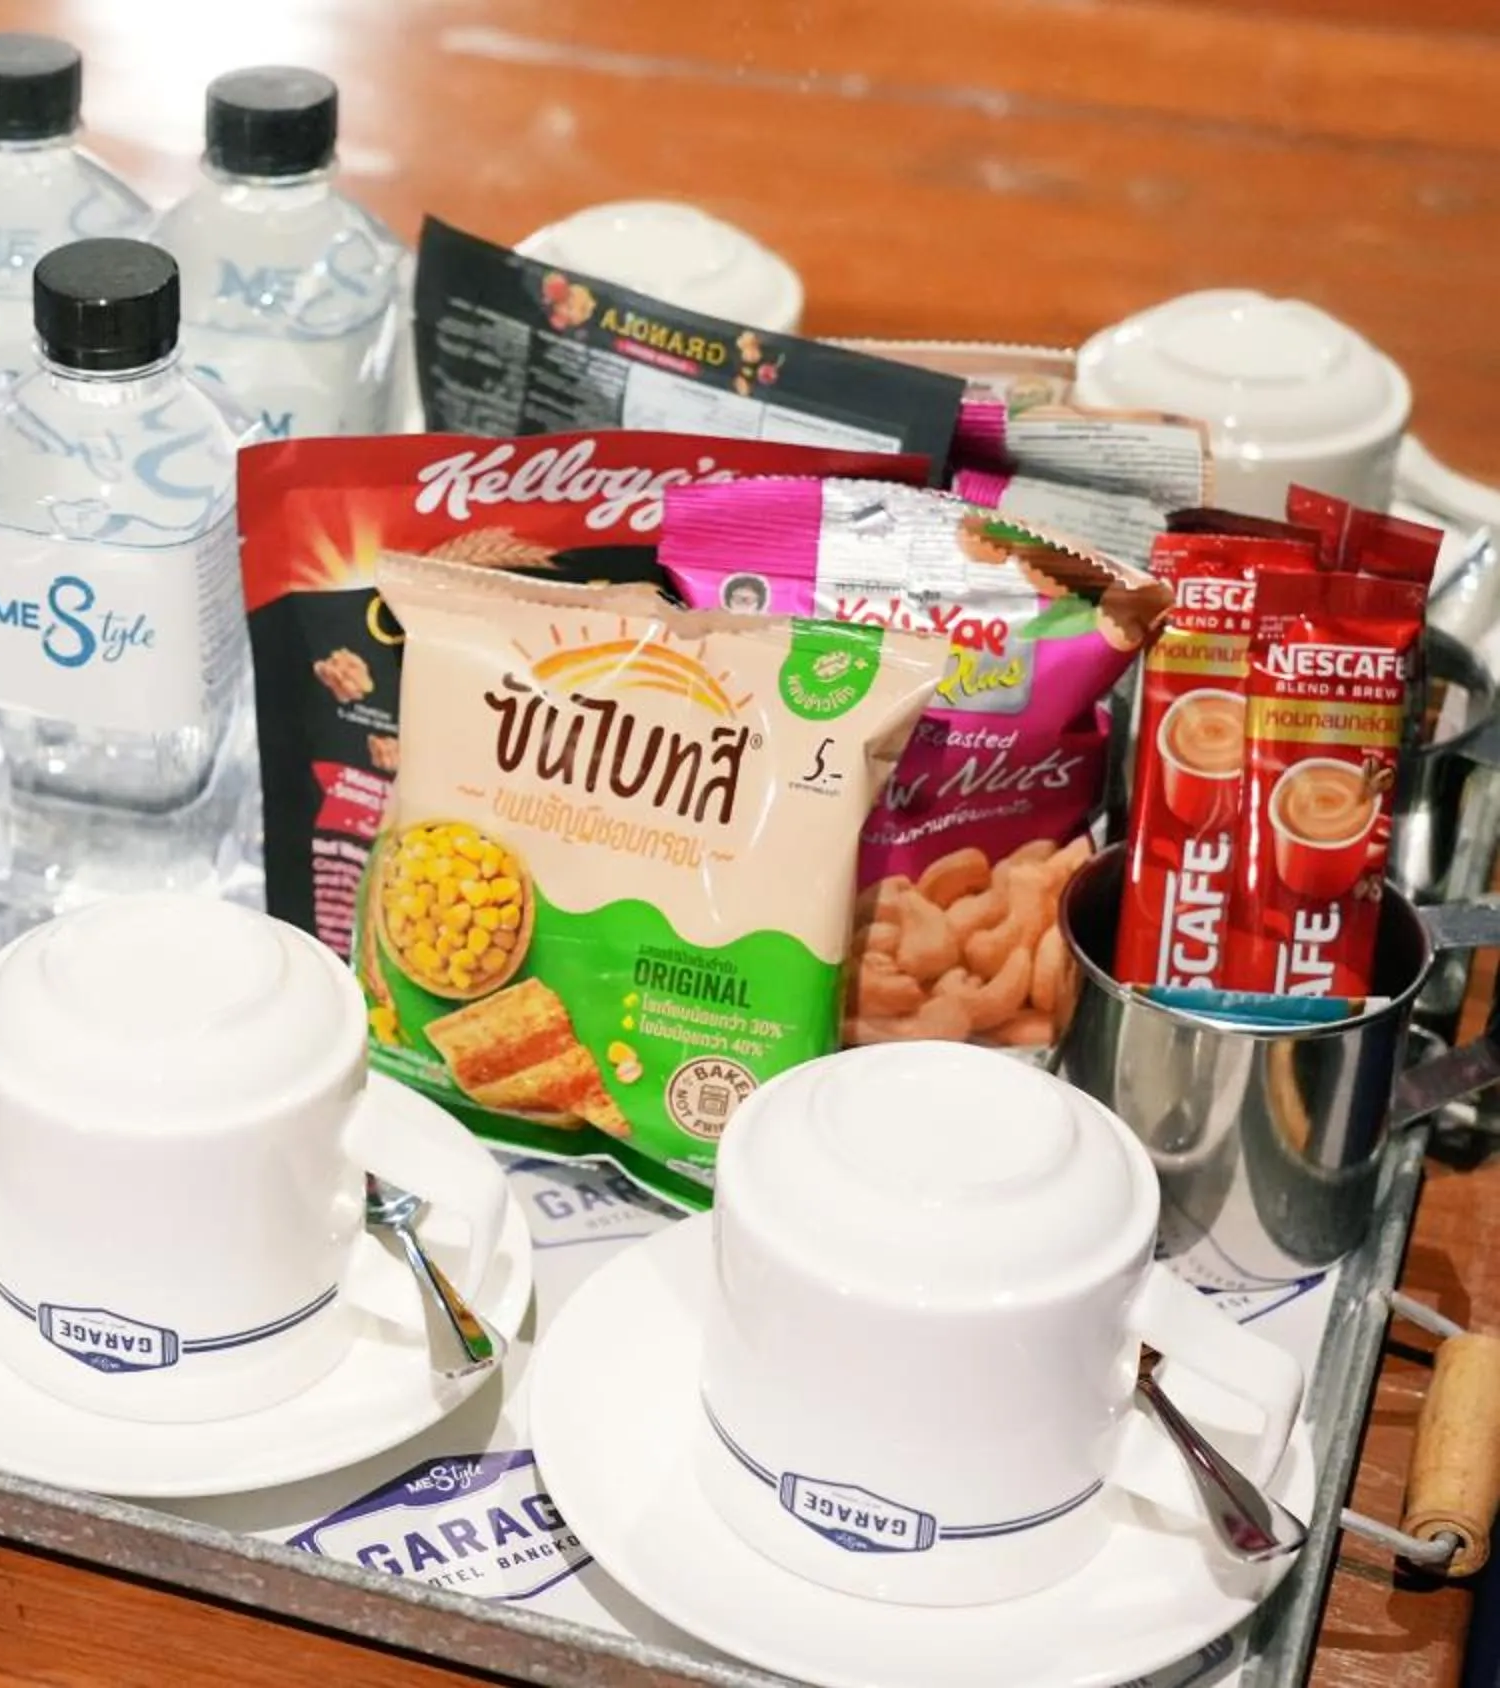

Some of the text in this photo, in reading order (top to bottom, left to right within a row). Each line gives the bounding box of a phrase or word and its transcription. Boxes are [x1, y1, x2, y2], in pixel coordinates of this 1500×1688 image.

[1275, 680, 1330, 696] BLEND
[1351, 685, 1398, 699] BREW
[937, 748, 1084, 797] Nuts
[633, 957, 752, 1010] ORIGINAL
[676, 1088, 693, 1118] NOT
[59, 1319, 152, 1354] GARAGE
[356, 1493, 567, 1577] GARAG
[803, 1490, 908, 1537] GARAGE
[428, 1534, 582, 1588] OTEL BANGKO
